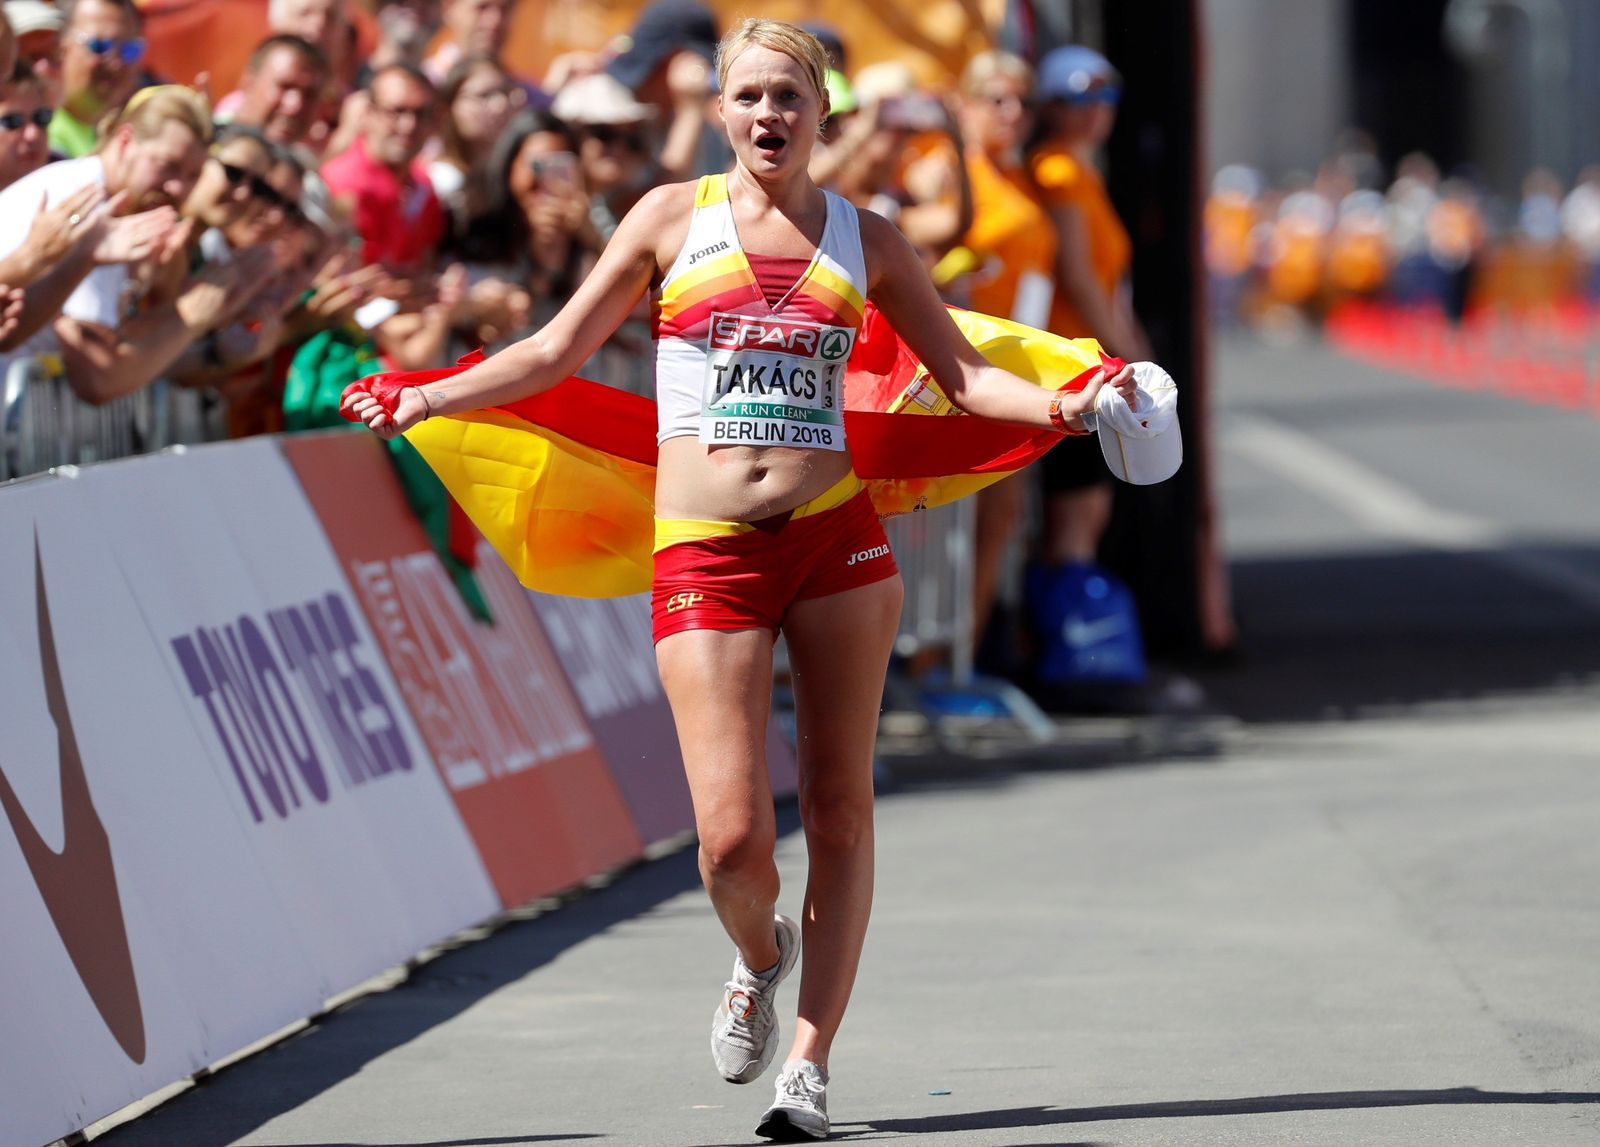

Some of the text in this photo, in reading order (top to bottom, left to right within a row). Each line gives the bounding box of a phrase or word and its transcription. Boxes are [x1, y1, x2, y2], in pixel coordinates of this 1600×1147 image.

[714, 318, 817, 353] SPAR
[713, 360, 817, 400] TAKÁCS
[741, 404, 769, 416] RUN
[714, 421, 833, 446] BERLIN 2018
[667, 592, 704, 613] ESP
[171, 613, 331, 824] TOYO
